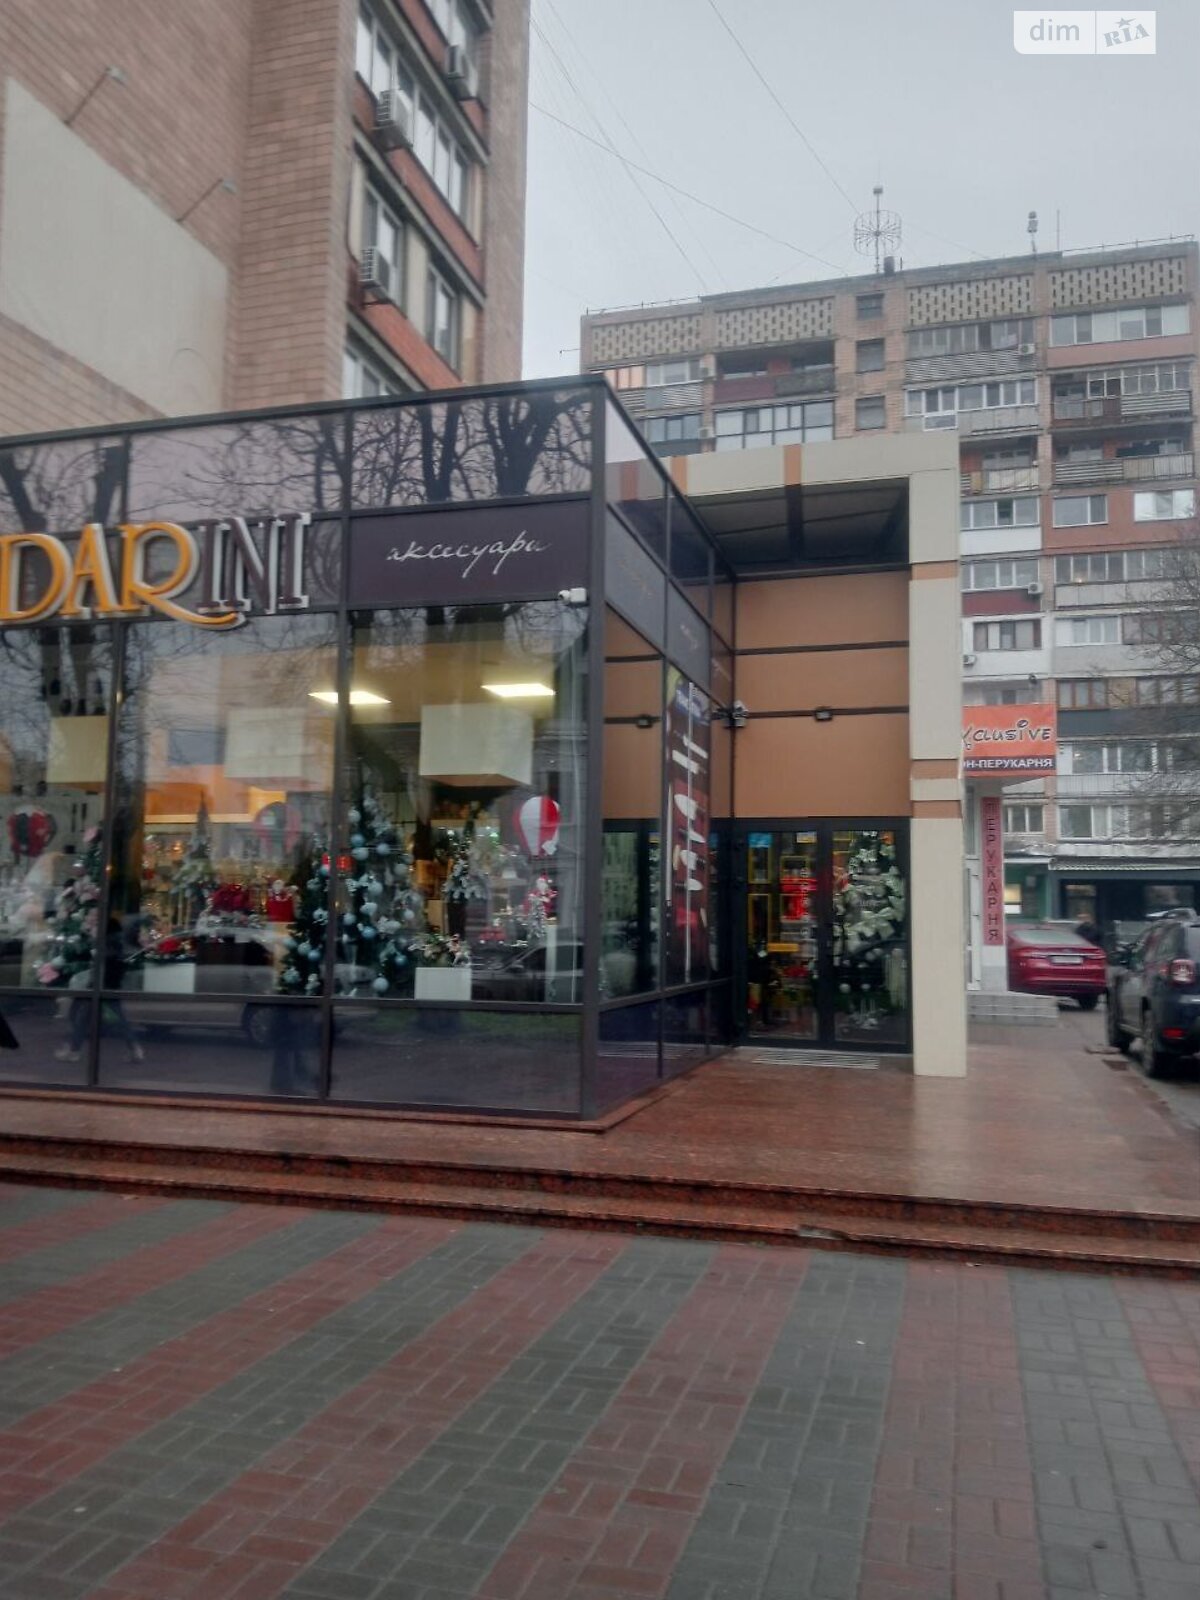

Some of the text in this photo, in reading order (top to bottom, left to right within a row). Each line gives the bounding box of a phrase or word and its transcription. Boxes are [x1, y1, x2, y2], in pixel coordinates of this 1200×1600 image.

[0, 512, 312, 631] DARINI
[963, 758, 1053, 769] Н-ПЕРУКАРНЯ
[985, 802, 999, 941] ПЕРУКАРНЯ
